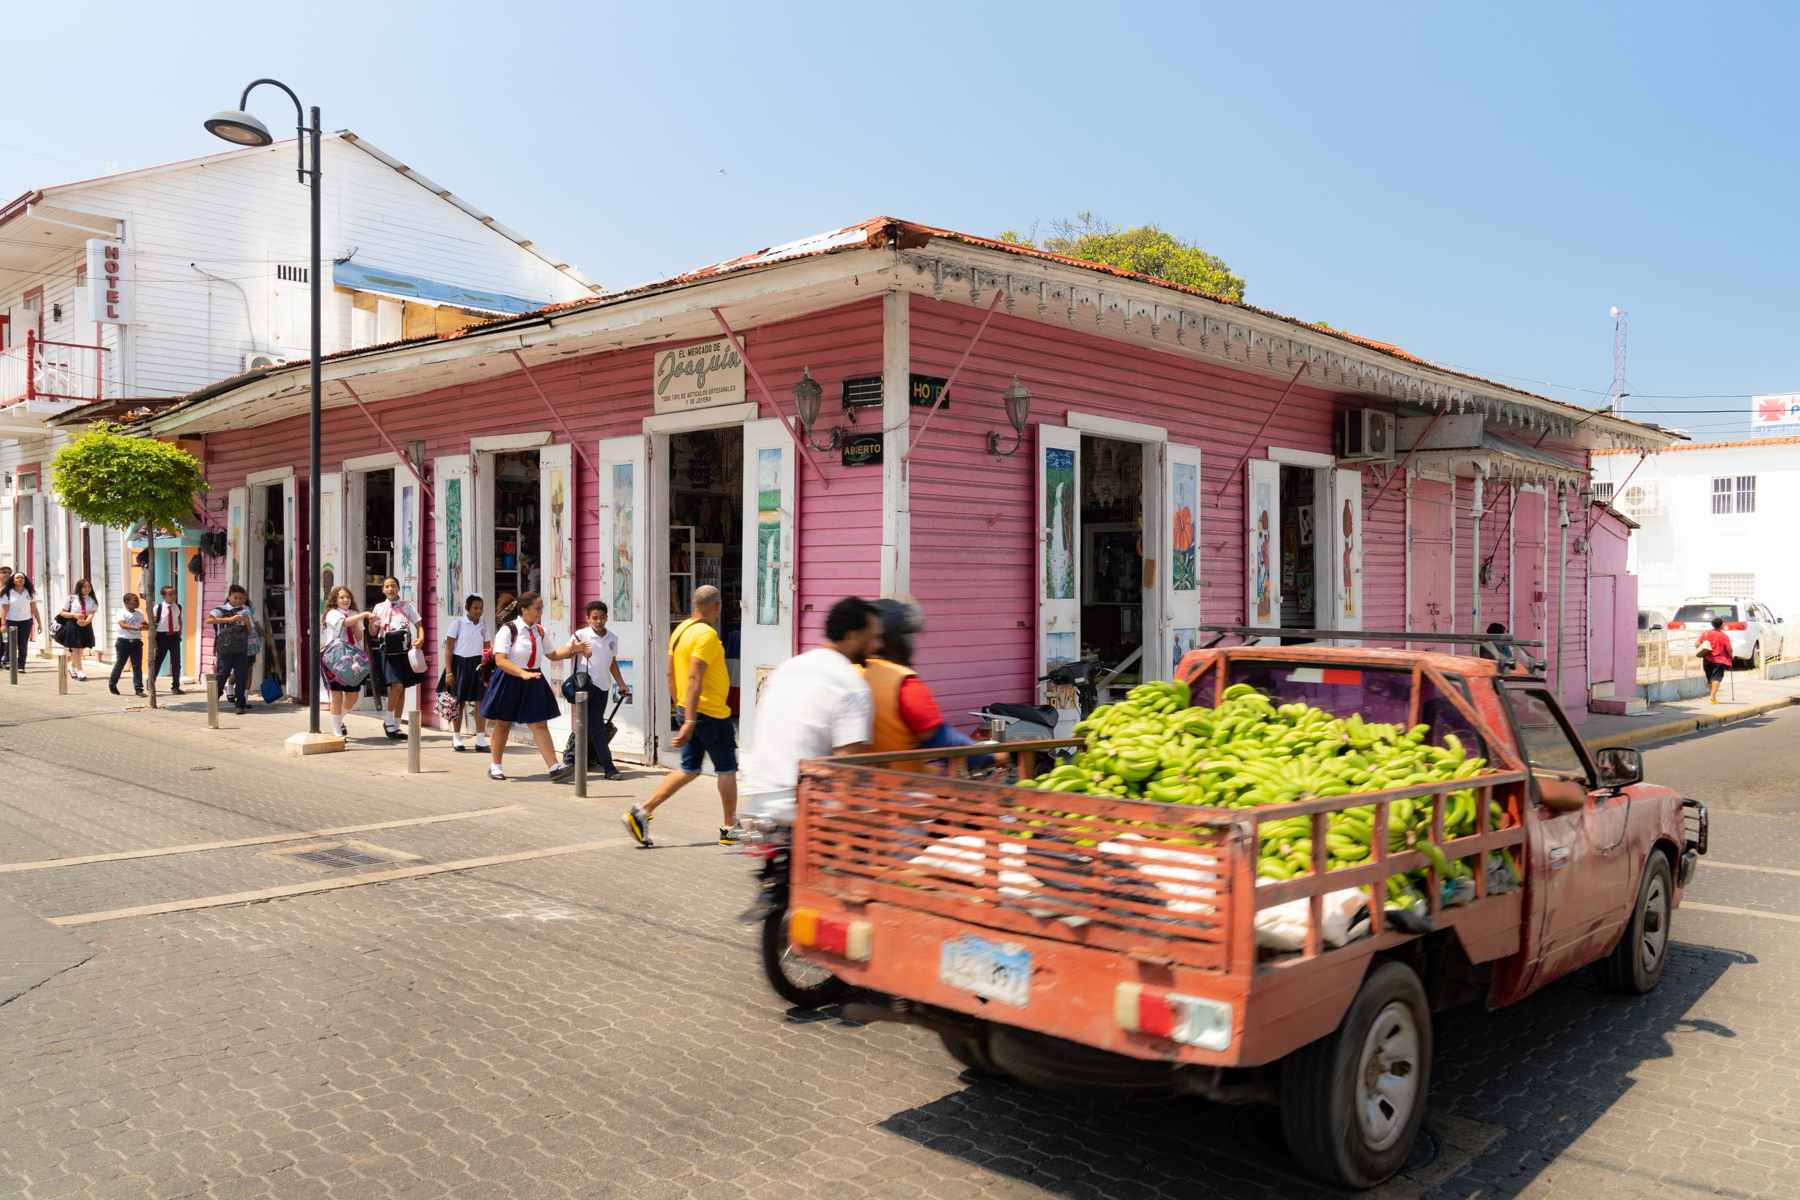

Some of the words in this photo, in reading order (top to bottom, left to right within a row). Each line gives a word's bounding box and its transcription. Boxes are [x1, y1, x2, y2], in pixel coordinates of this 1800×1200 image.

[104, 245, 119, 318] HOTEL
[679, 350, 686, 359] EL
[687, 345, 712, 357] MERCADO
[713, 343, 721, 352] DE
[661, 395, 671, 403] TODO
[671, 394, 680, 402] TIPO
[680, 392, 686, 400] DE
[687, 390, 708, 398] ARTICULOS
[708, 385, 736, 394] ARTESANALES
[695, 396, 712, 404] JOYERIA
[844, 444, 881, 456] ABIERTO
